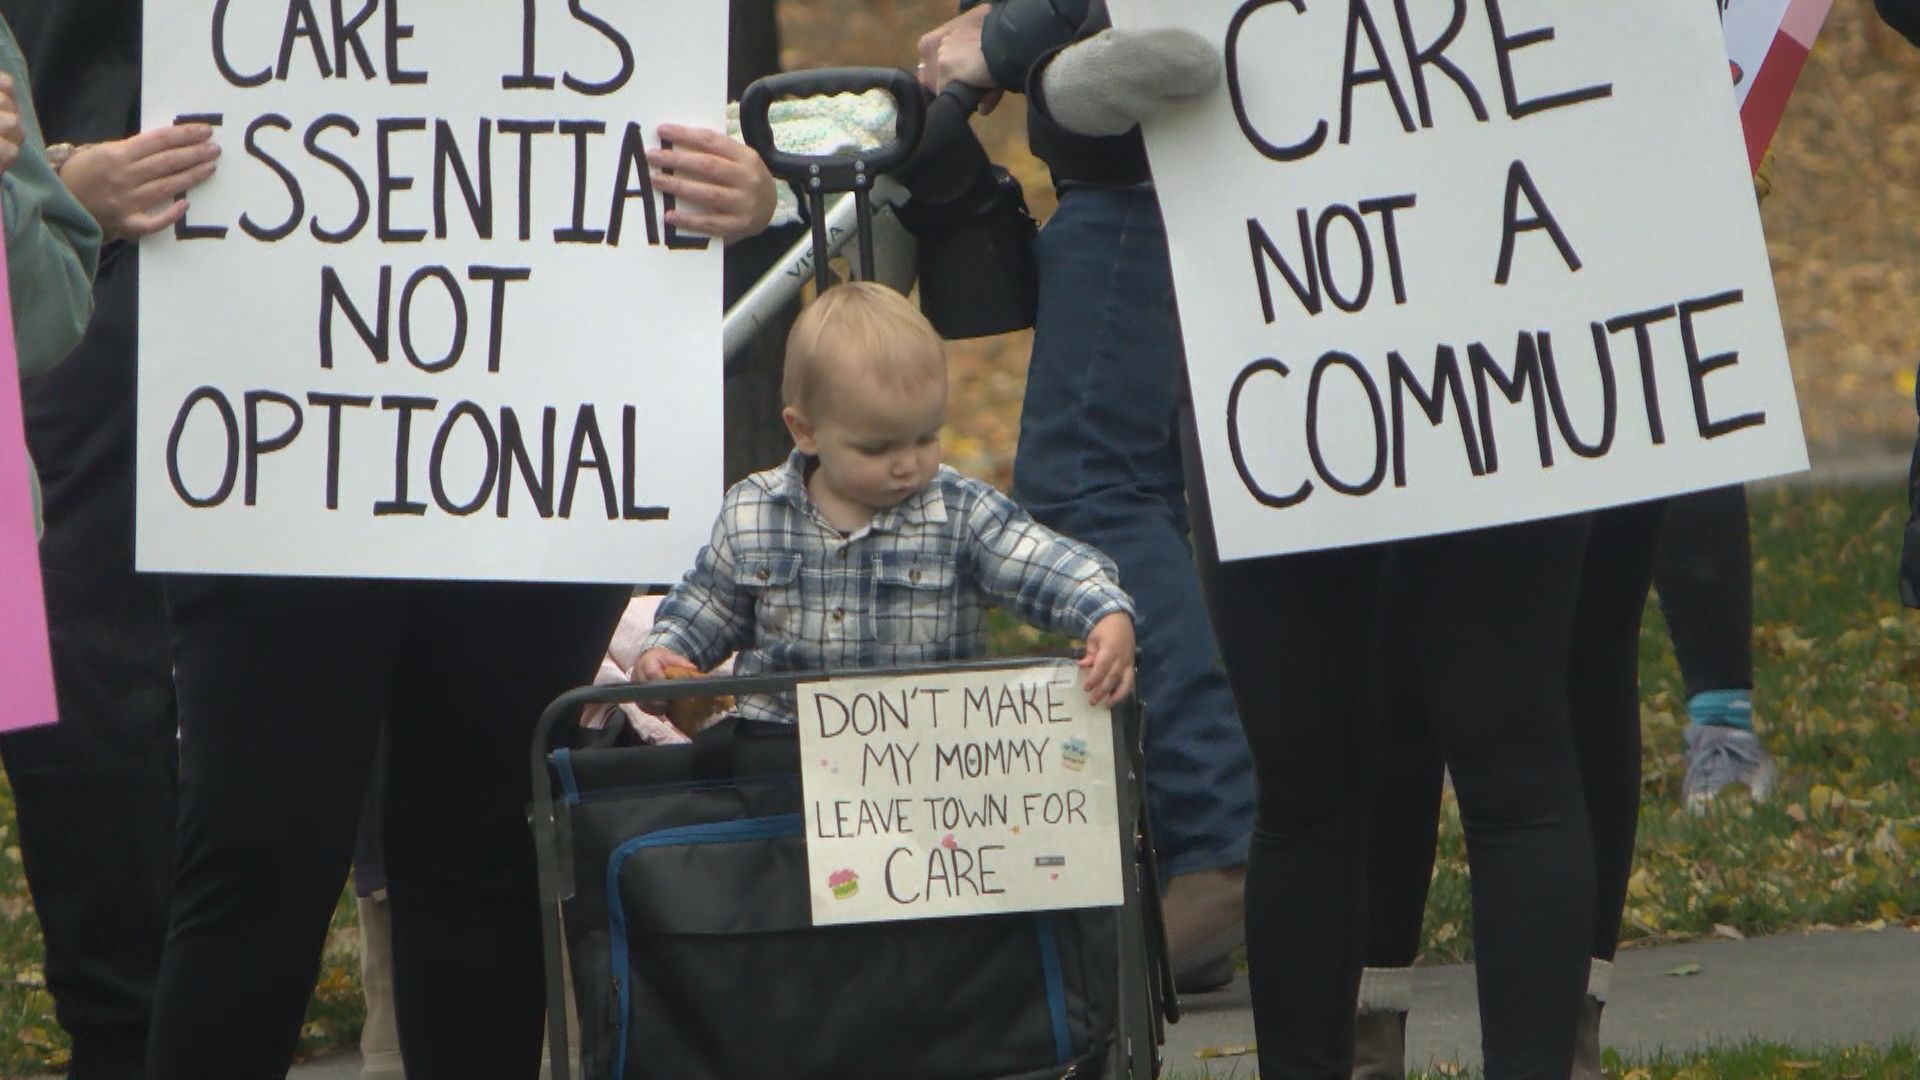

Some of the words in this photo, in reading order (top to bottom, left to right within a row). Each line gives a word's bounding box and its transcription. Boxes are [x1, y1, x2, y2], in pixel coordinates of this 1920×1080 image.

[212, 0, 428, 87] CARE
[501, 0, 635, 96] IS
[1225, 0, 1613, 162] CARE
[1246, 193, 1417, 325] NOT
[1494, 159, 1583, 285] A
[319, 264, 531, 373] NOT
[1226, 289, 1766, 509] COMMUTE
[166, 385, 670, 520] OPTIONAL
[814, 687, 949, 738] DON'T
[963, 679, 1073, 727] MAKE
[861, 742, 919, 786] MY
[935, 737, 1049, 781] MOMMY
[816, 799, 913, 838] LEAVE
[923, 794, 1007, 830] TOWN
[1023, 789, 1087, 826] FOR
[885, 845, 1006, 904] CARE
